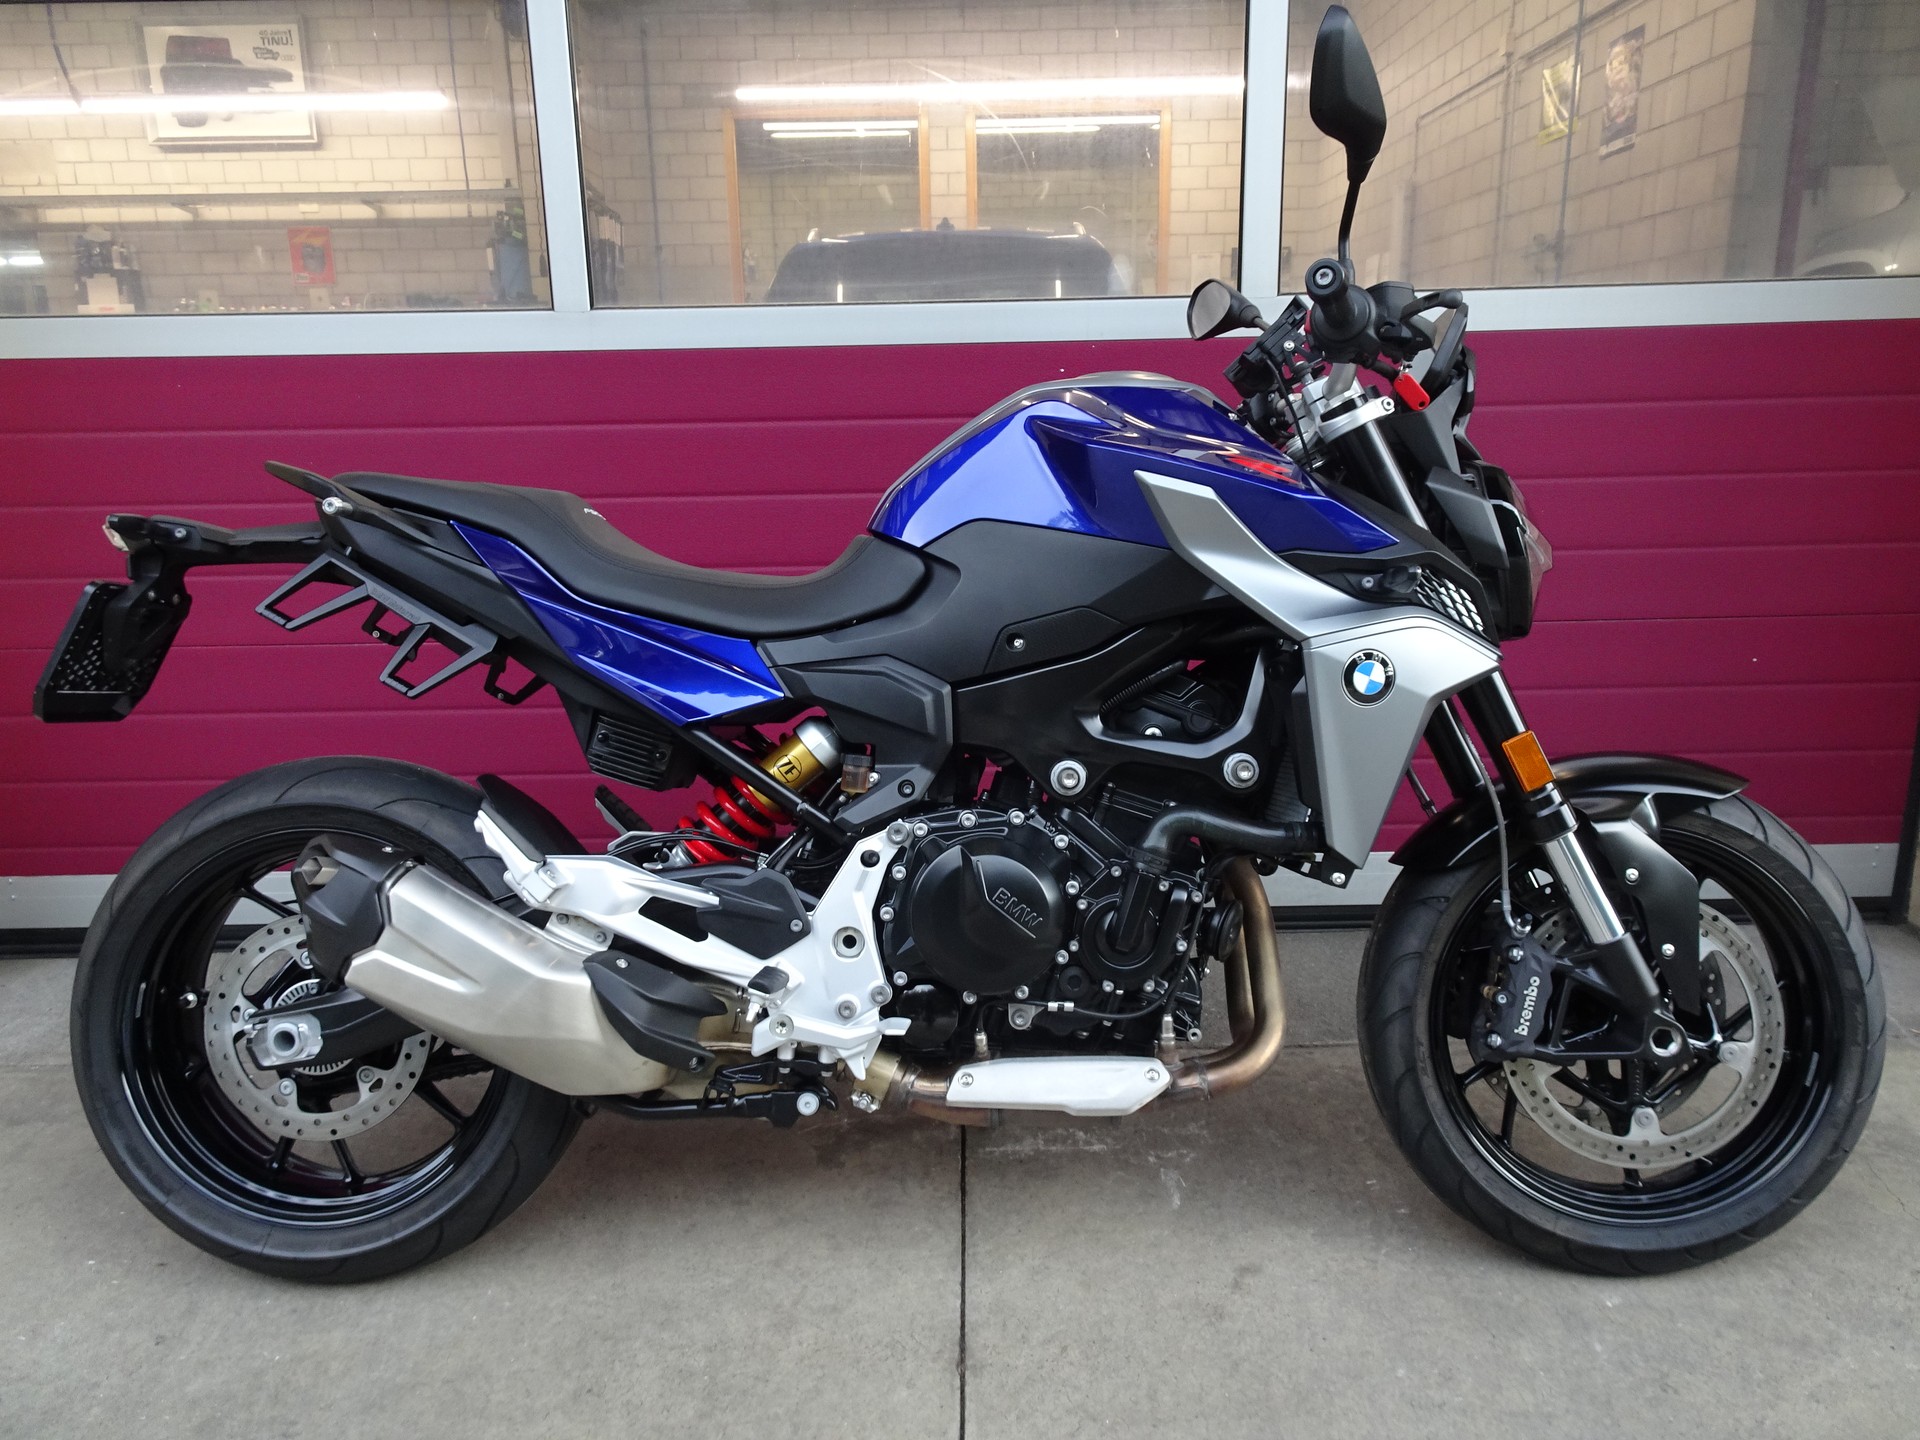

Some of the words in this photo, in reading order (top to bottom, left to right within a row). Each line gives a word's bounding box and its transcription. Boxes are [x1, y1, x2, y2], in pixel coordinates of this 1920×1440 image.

[260, 29, 294, 46] TINU!
[1355, 653, 1394, 676] BMW
[992, 887, 1043, 928] BMW
[1514, 976, 1540, 1036] brembo
